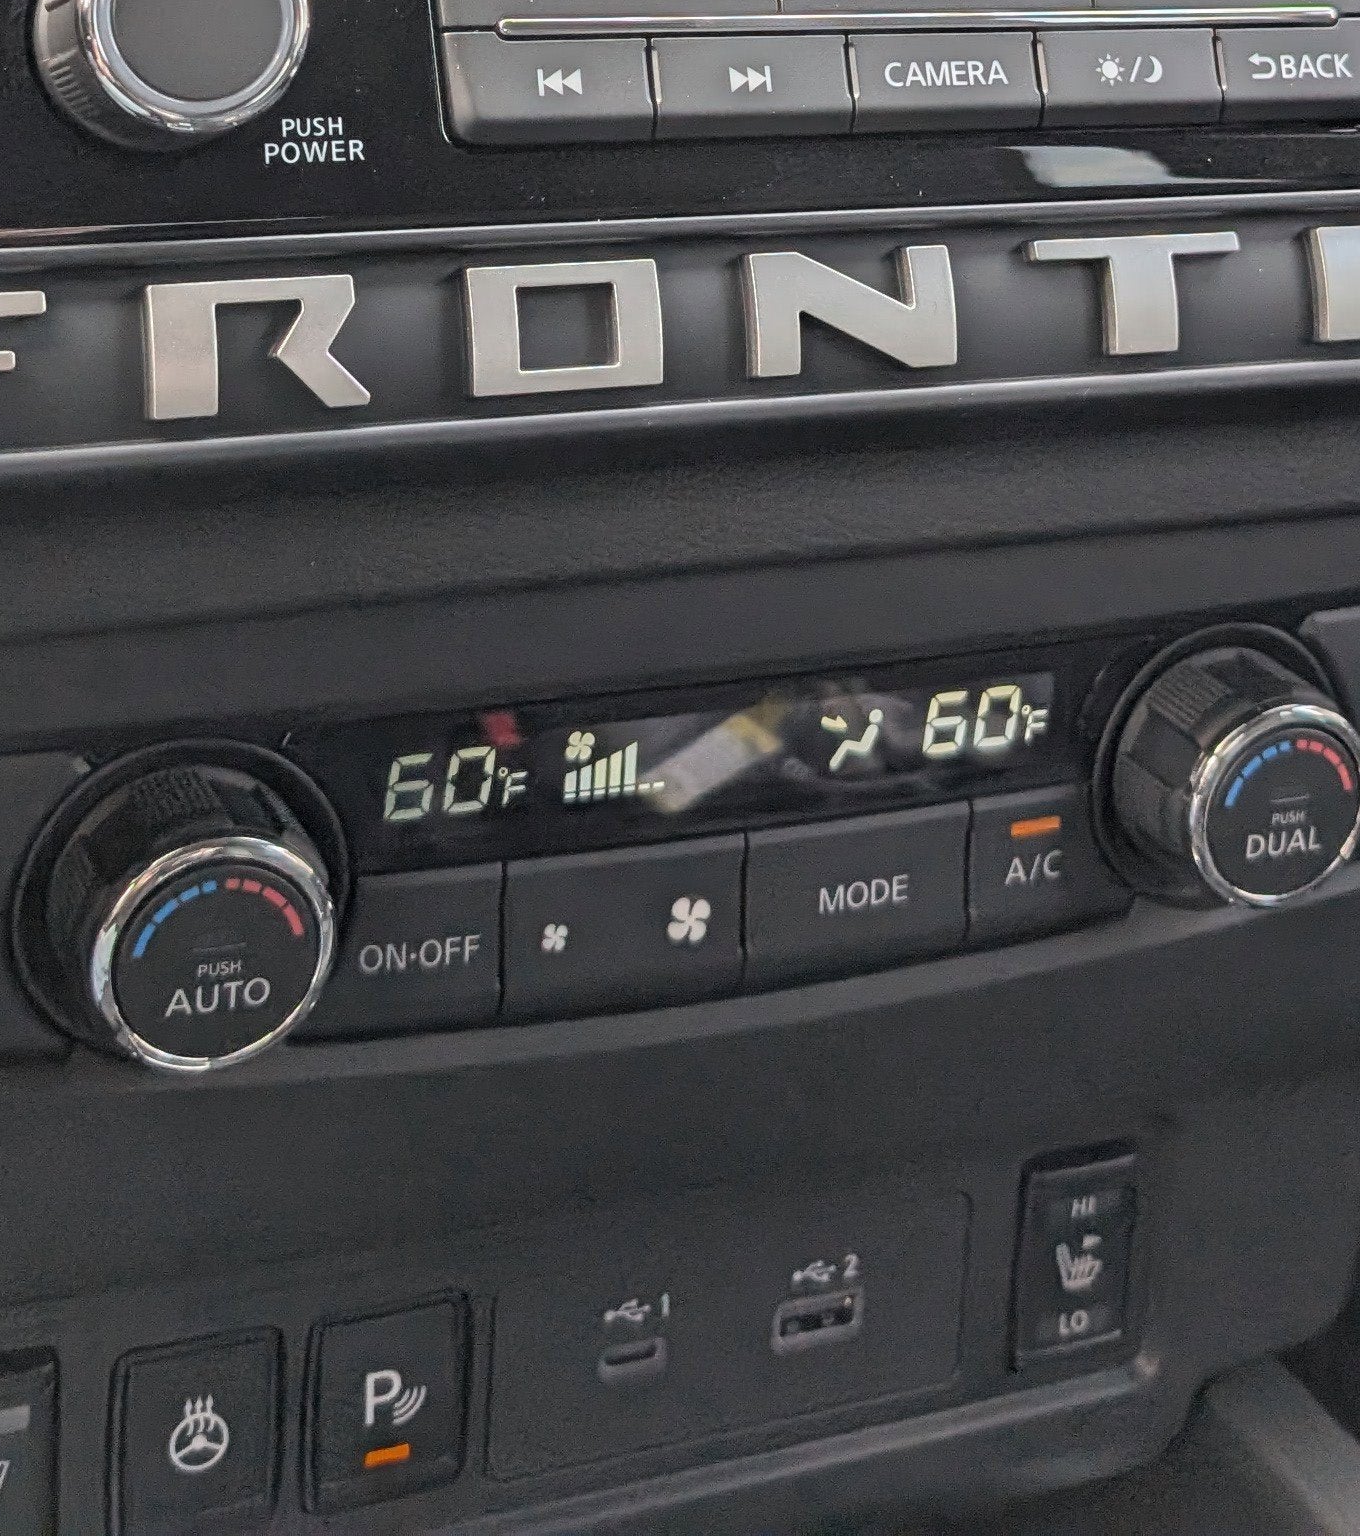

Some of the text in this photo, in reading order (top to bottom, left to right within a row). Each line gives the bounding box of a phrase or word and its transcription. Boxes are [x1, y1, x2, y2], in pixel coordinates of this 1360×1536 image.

[884, 60, 1008, 89] CAMERA
[1281, 52, 1352, 80] BACK
[281, 116, 344, 138] PUSH
[264, 139, 365, 166] POWER
[1271, 809, 1305, 826] PUSH
[1245, 826, 1323, 859] DUAL
[1005, 848, 1061, 887] A/C
[819, 874, 909, 914] MODE
[197, 960, 242, 977] PUSH
[165, 978, 271, 1018] AUTO
[1072, 1196, 1096, 1218] HI
[844, 1253, 859, 1278] 2
[660, 1293, 669, 1317] 1
[1059, 1310, 1089, 1335] LO
